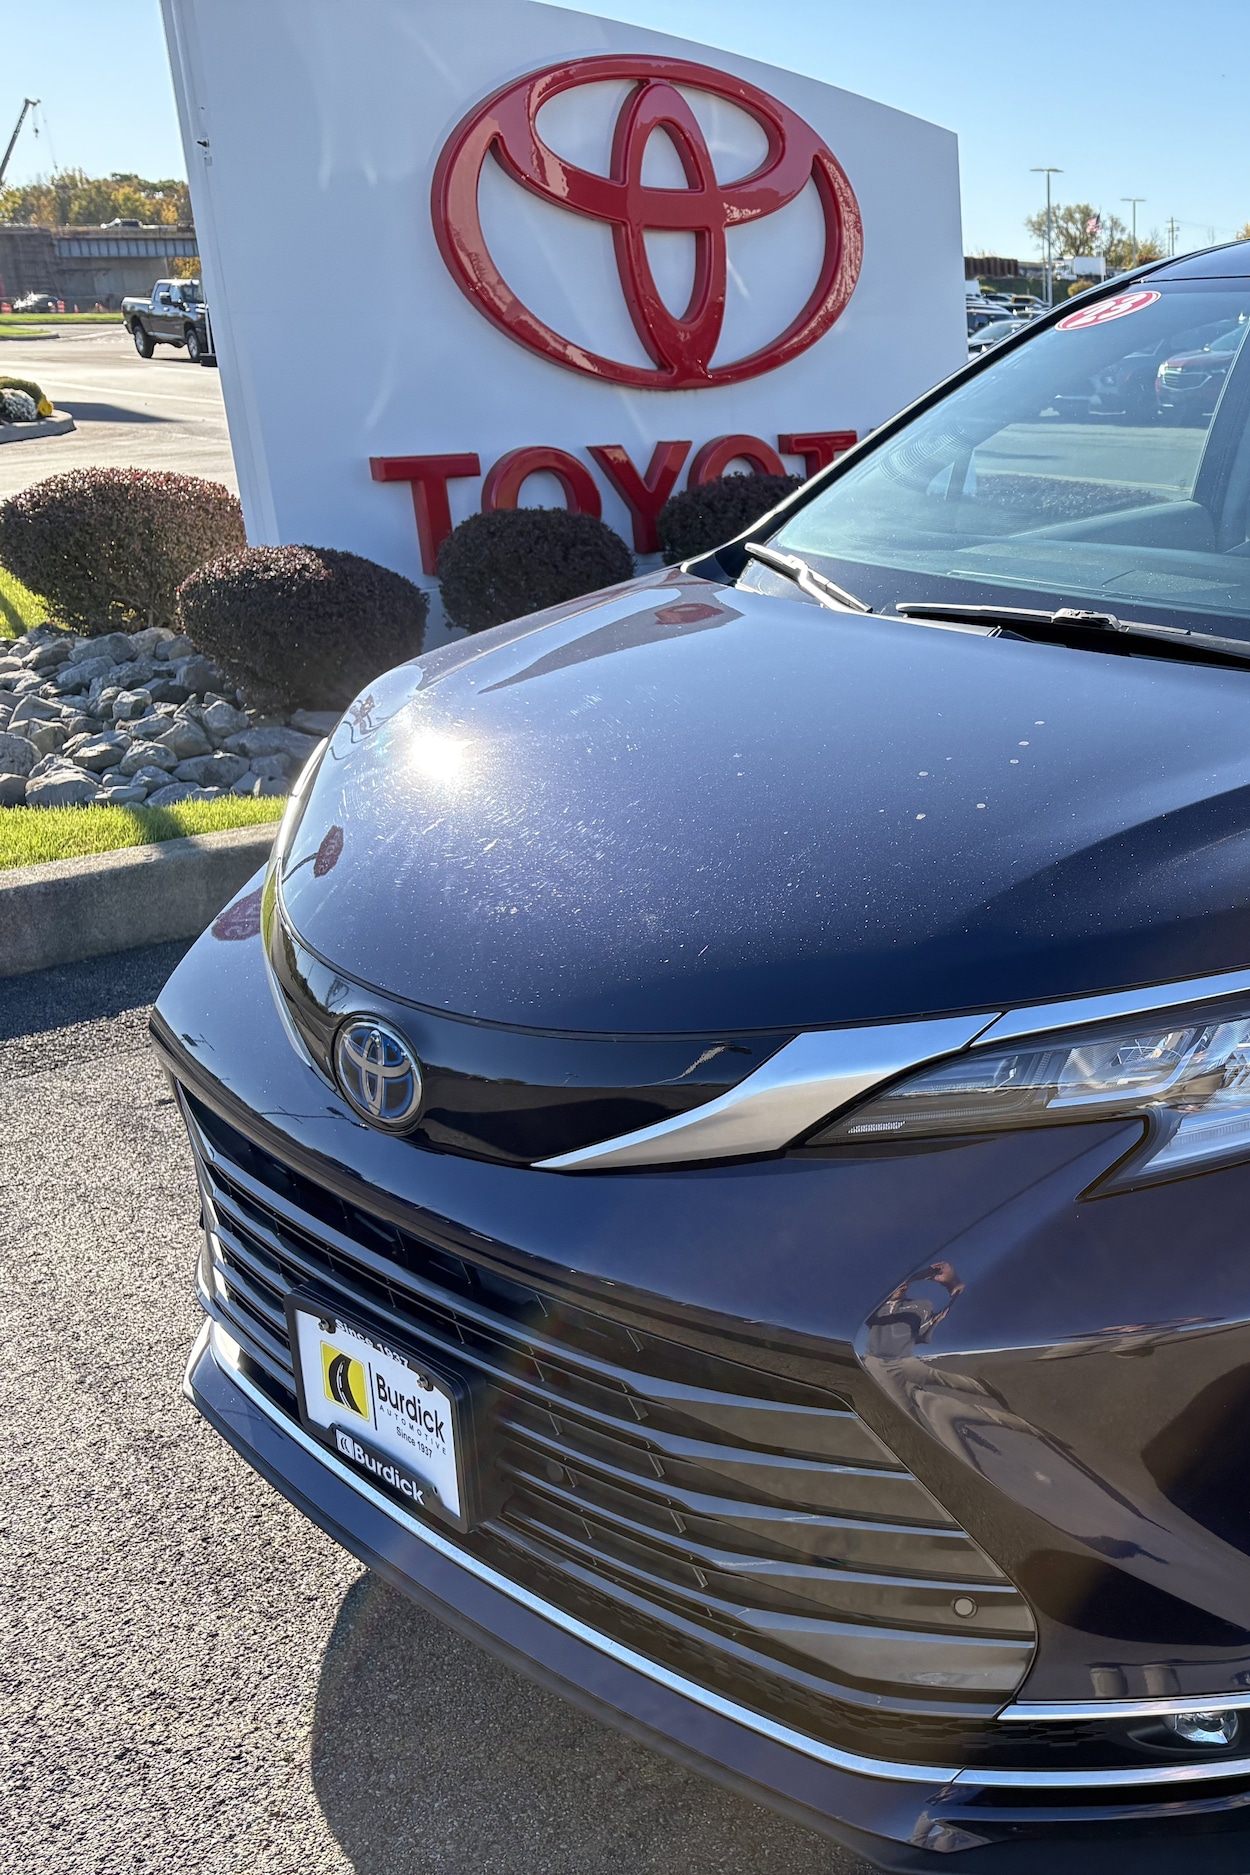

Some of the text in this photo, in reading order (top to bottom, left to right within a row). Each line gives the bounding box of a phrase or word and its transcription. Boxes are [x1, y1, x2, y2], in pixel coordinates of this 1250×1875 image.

[1066, 293, 1148, 328] 23
[335, 1319, 409, 1367] Since 1937
[376, 1373, 445, 1443] Burdick
[379, 1405, 446, 1455] AUTOMOTIVE
[396, 1427, 432, 1458] Since 1937
[354, 1444, 425, 1505] Burdick
